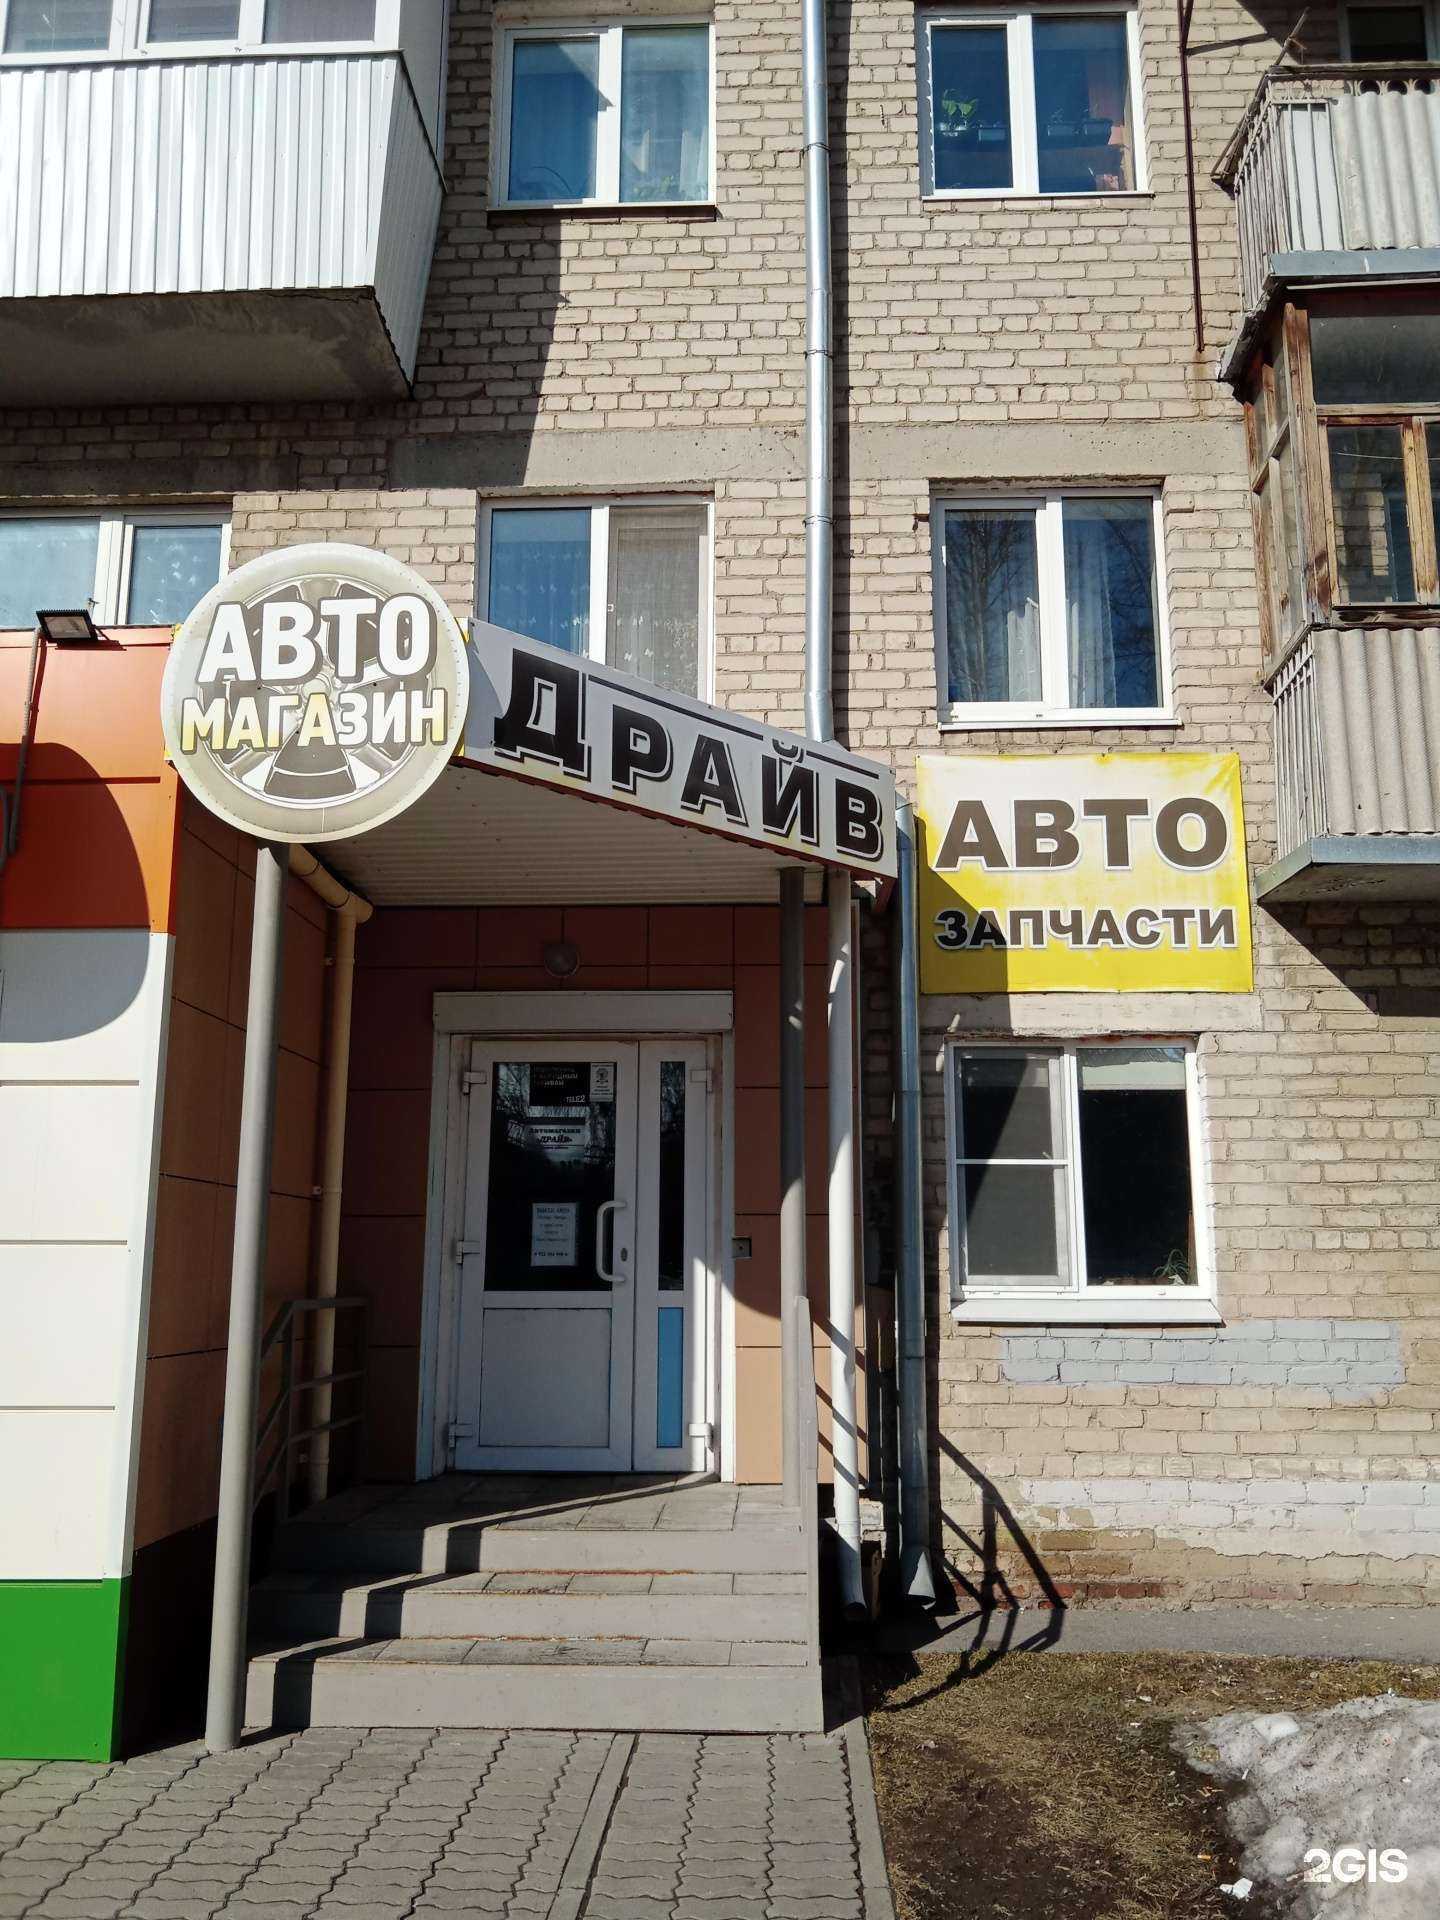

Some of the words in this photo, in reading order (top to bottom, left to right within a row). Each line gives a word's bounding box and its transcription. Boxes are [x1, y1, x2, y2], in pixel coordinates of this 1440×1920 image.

[197, 593, 436, 684] АВТО
[181, 688, 447, 754] МАГАЗИН
[494, 648, 882, 861] ДРАЙВ
[935, 797, 1228, 868] АВТО
[936, 909, 1236, 947] ЗАПЧАСТИ
